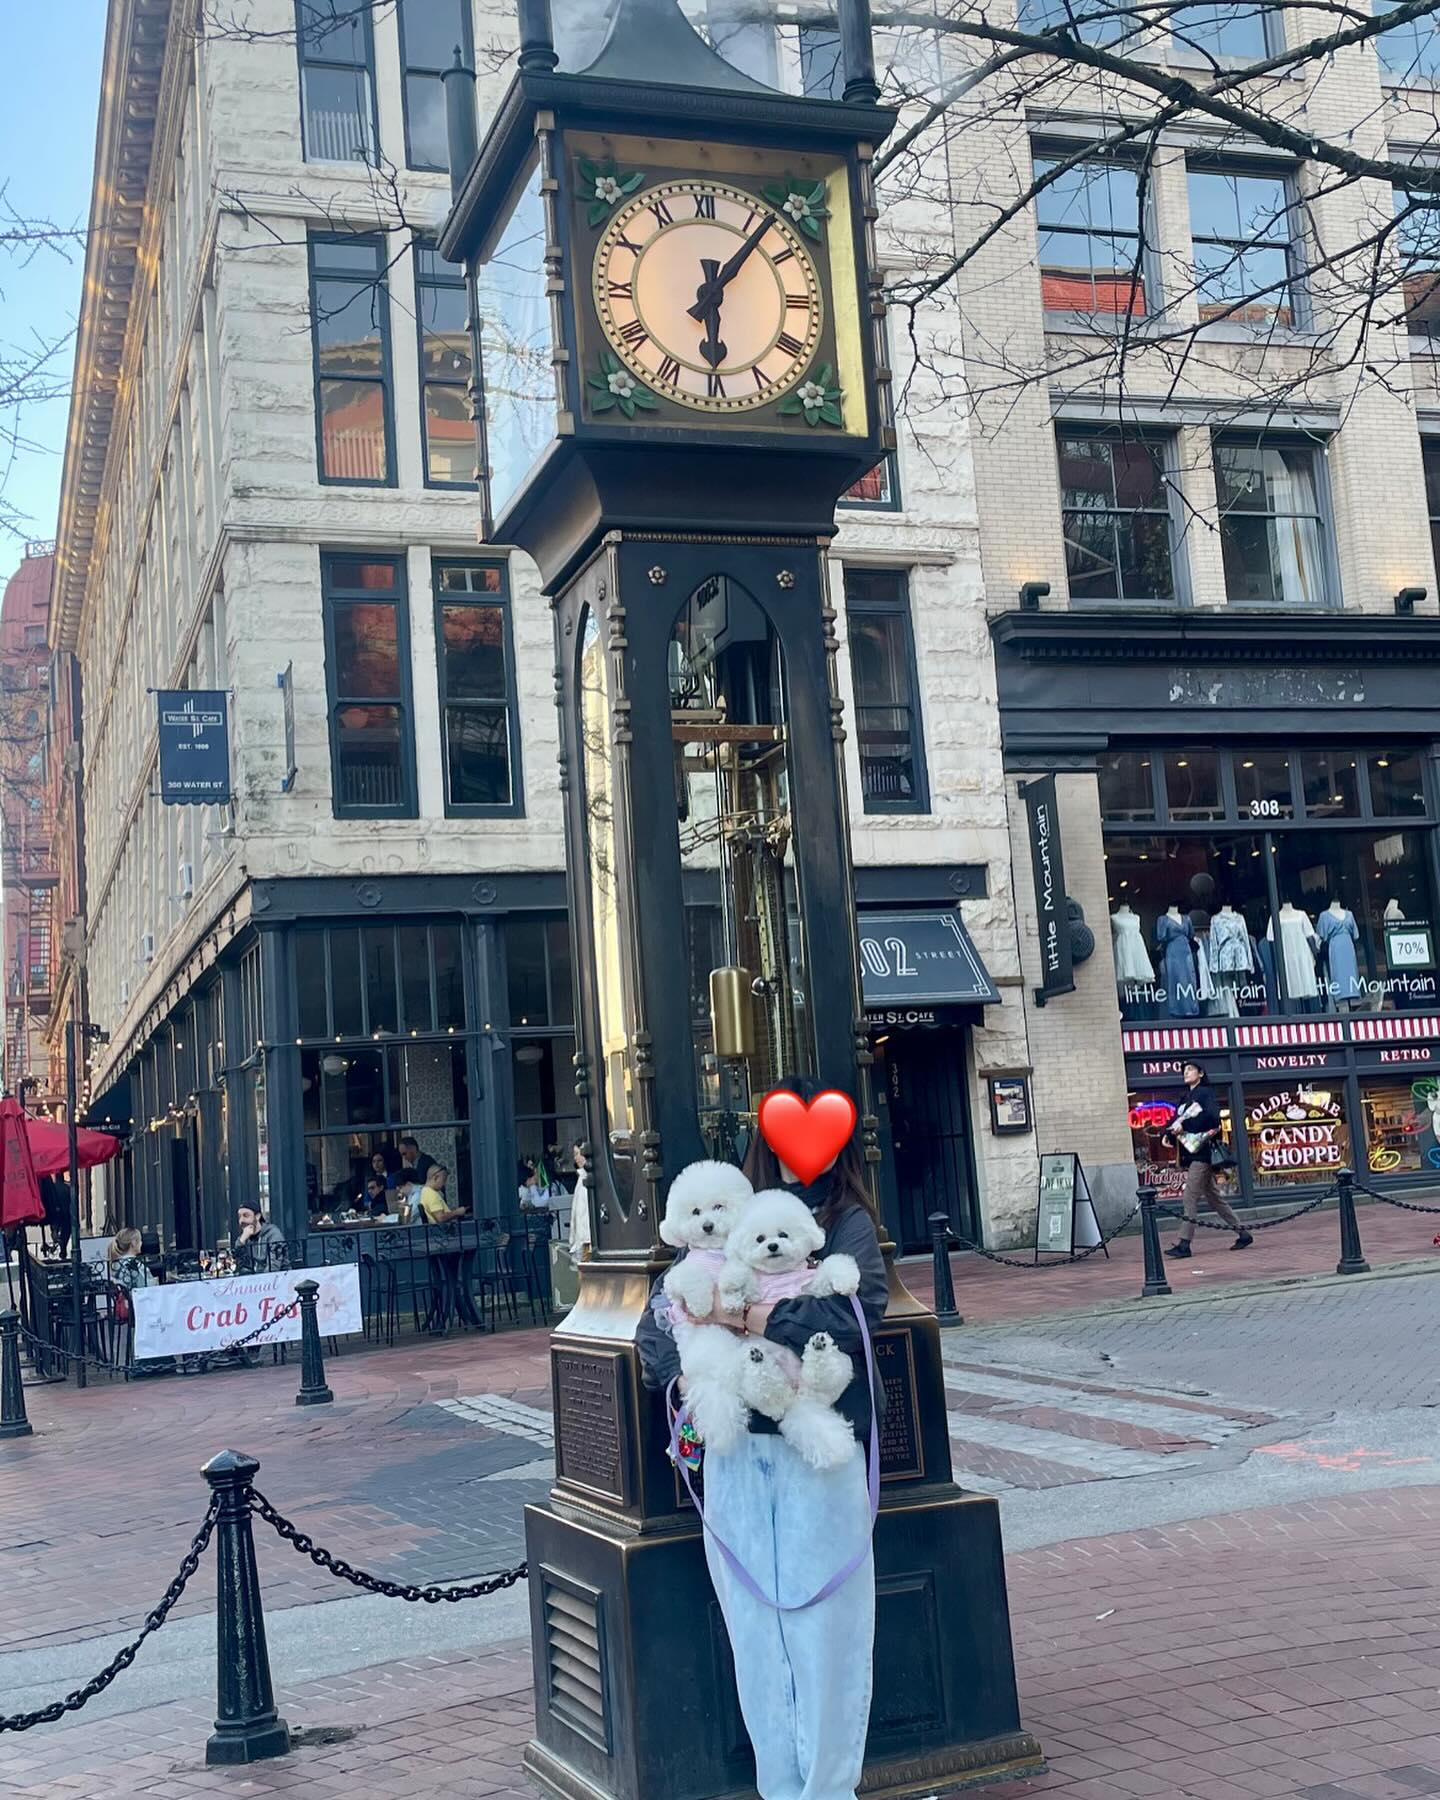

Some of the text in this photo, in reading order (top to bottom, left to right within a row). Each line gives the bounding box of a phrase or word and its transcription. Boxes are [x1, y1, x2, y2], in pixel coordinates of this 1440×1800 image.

[1250, 799, 1280, 816] 308
[1036, 804, 1059, 972] little Mountain
[860, 936, 963, 977] 02 STREET
[1397, 941, 1424, 955] 70%
[1124, 979, 1267, 1005] little Mountain
[1349, 973, 1436, 994] Mountain
[906, 1010, 935, 1023] CAFE
[1256, 1053, 1328, 1070] NOVELTY
[1380, 1047, 1431, 1062] RETRO
[1142, 1060, 1185, 1075] IMPO
[1251, 1091, 1292, 1121] OLDE
[1260, 1125, 1336, 1146] CANDY
[1261, 1145, 1341, 1168] SHOPPE
[214, 1278, 278, 1297] Annual
[187, 1297, 300, 1332] Crab Fes
